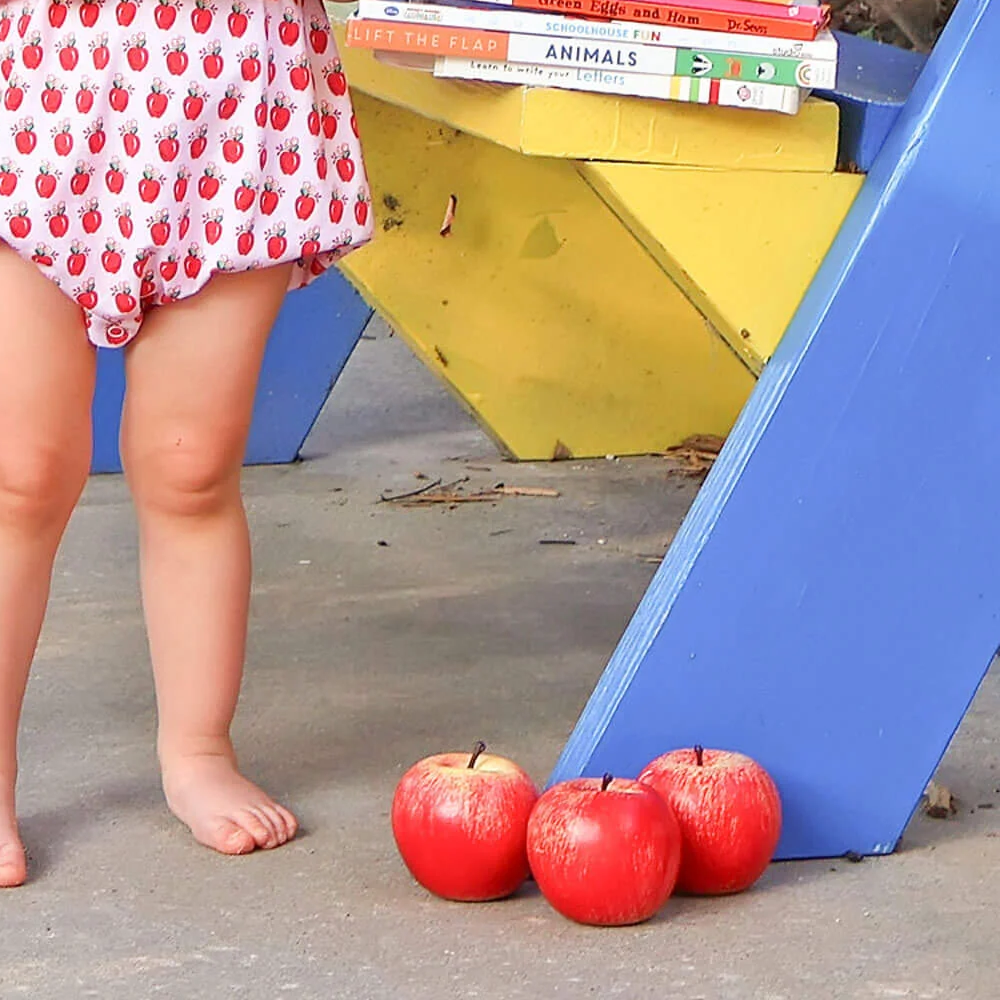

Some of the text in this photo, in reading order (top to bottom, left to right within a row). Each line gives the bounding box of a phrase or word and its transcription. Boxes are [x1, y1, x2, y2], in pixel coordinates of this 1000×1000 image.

[590, 0, 626, 16] Eggs
[633, 6, 660, 19] and
[667, 10, 700, 25] Ham
[353, 28, 497, 52] LIFT THE FLAP
[546, 21, 661, 41] SCHOOLHOUSE FUN
[545, 44, 638, 67] ANIMALS
[470, 60, 625, 85] Learn to write your Letters
